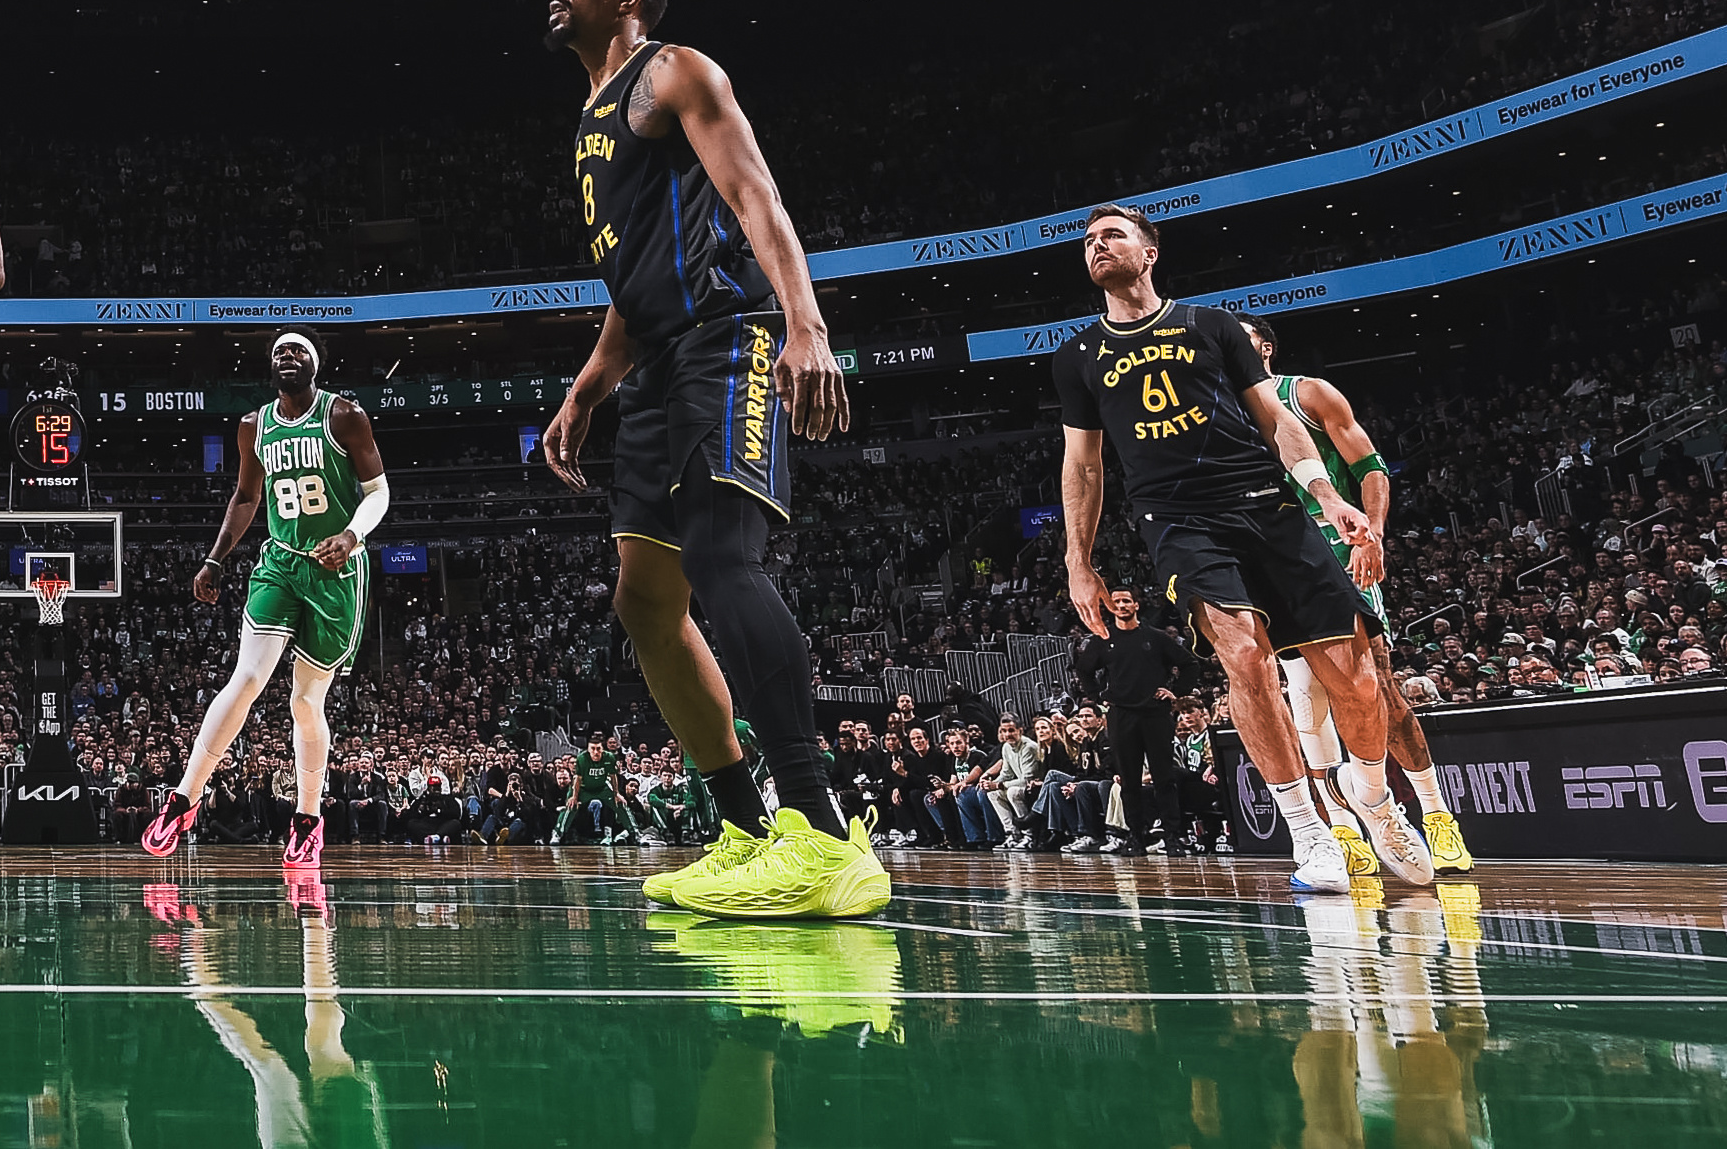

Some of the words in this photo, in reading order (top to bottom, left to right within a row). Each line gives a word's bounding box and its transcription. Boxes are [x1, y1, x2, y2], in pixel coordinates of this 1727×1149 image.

[1369, 119, 1467, 168] ZENNI
[1497, 93, 1569, 125] Eyewear
[1571, 82, 1597, 101] for
[1598, 54, 1686, 92] Everyone
[576, 133, 615, 162] LDEN
[582, 173, 595, 226] 8
[1498, 213, 1608, 262] ZENNI
[1643, 188, 1723, 222] Eyewear
[911, 229, 1014, 262] ZENNI
[1039, 219, 1086, 240] Eyewe
[96, 303, 182, 319] ZENNI
[209, 304, 266, 318] Eyewear
[268, 304, 289, 317] for
[291, 304, 353, 318] Everyone
[490, 286, 585, 309] ZENNI
[1220, 297, 1244, 313] for
[1245, 282, 1327, 310] Everyone
[873, 350, 905, 365] 7:21
[910, 347, 935, 362] PM
[1103, 344, 1195, 387] GOLDEN
[530, 378, 544, 386] AST
[745, 324, 772, 461] WARRIORS
[1142, 370, 1180, 413] 61
[100, 393, 126, 411] 15
[145, 392, 205, 411] BOSTON
[380, 396, 406, 408] 5/10
[429, 394, 449, 405] 3/5
[36, 416, 71, 432] 6:29
[1135, 406, 1208, 440] STATE
[41, 433, 69, 464] 15
[263, 437, 324, 476] BOSTON
[36, 477, 78, 486] TISSOT
[274, 475, 328, 519] 88
[391, 555, 416, 563] ULTRA
[42, 692, 56, 705] GET
[42, 706, 57, 719] THE
[45, 720, 60, 735] App
[18, 785, 79, 800] KIA
[1466, 761, 1536, 813] NEXT
[1561, 764, 1666, 809] ESPN
